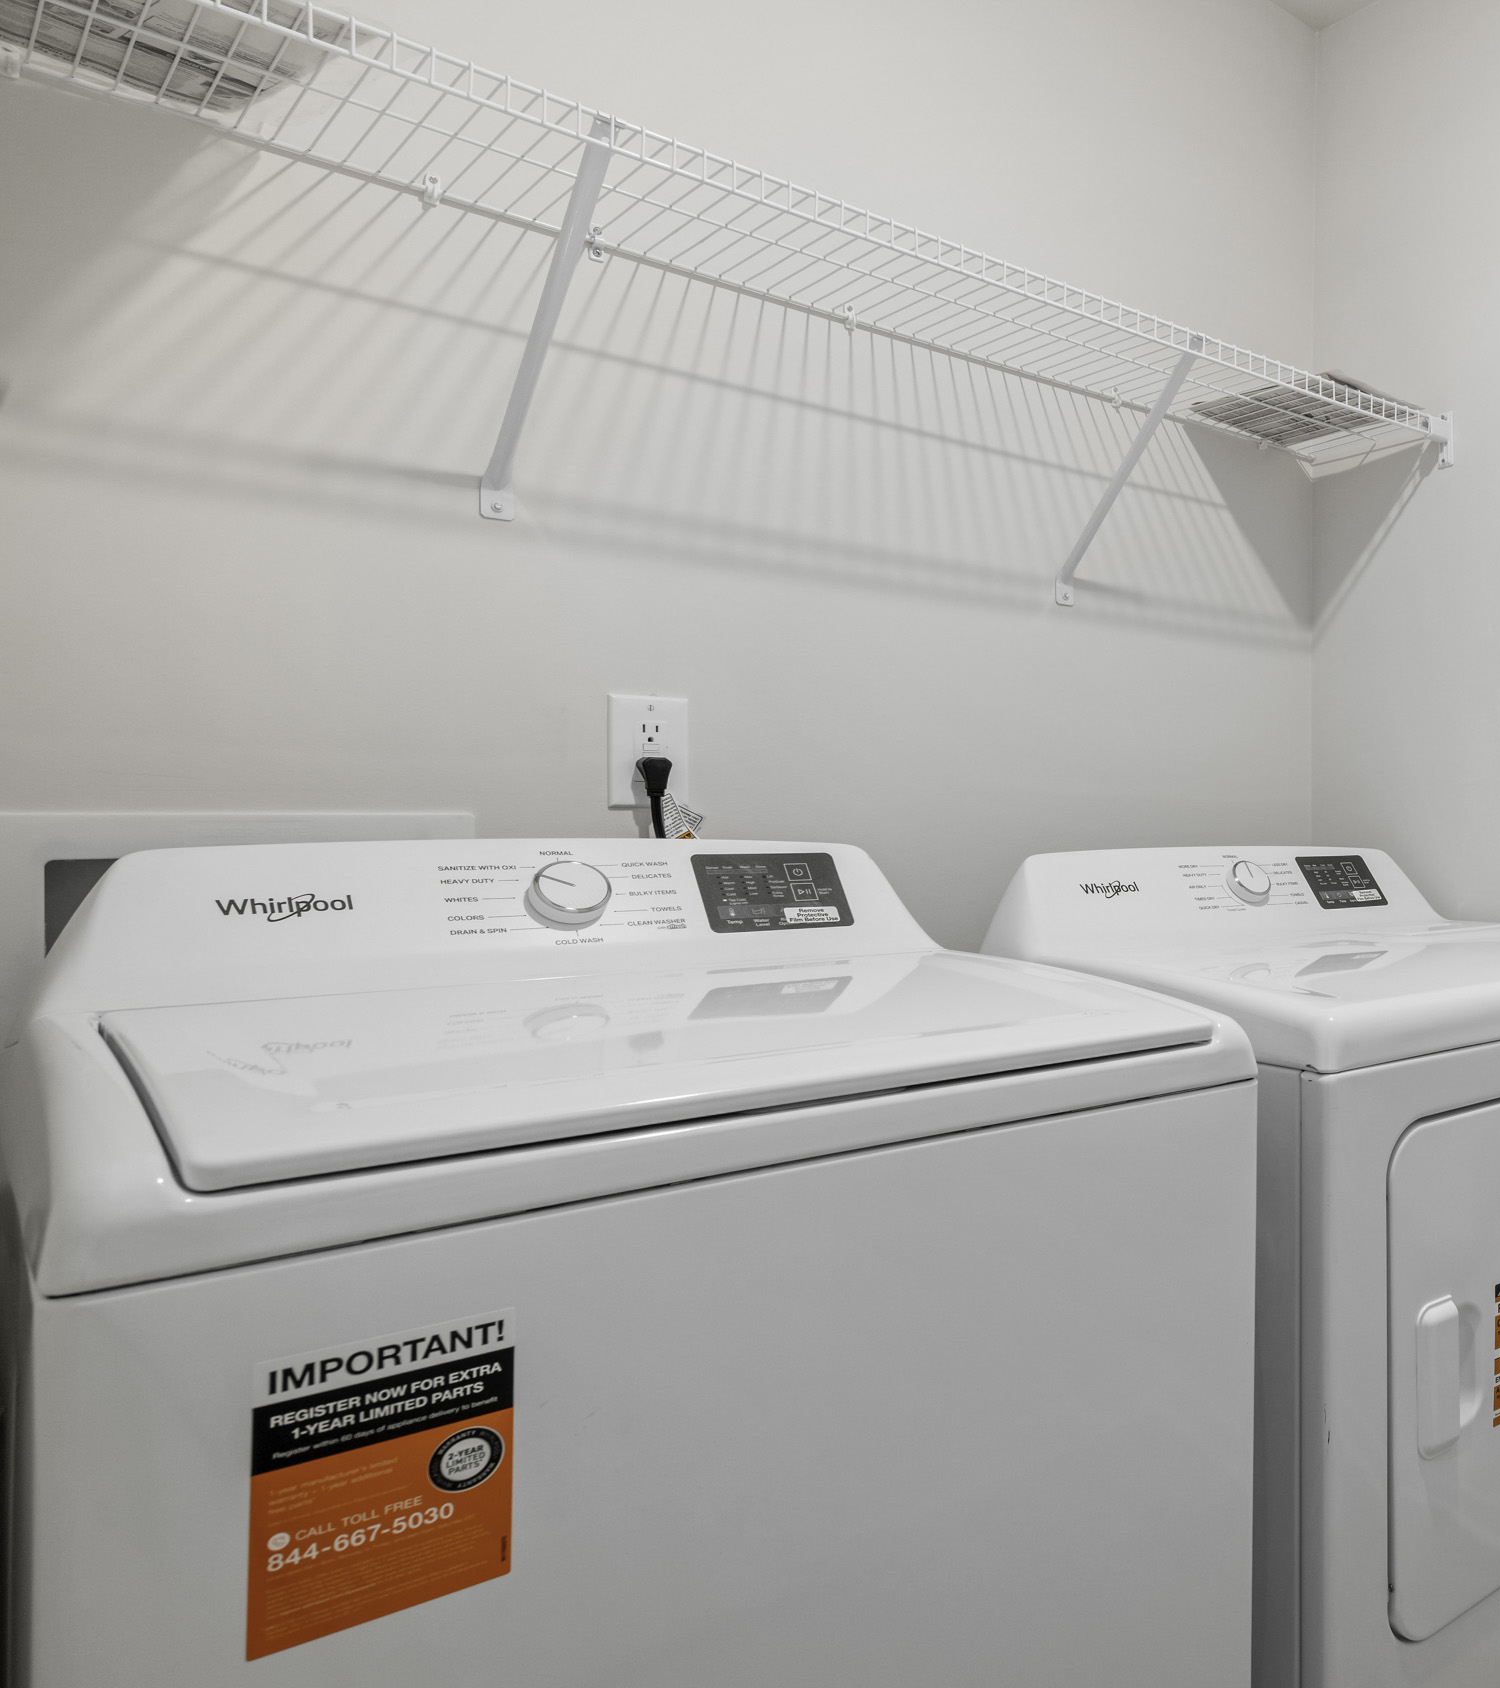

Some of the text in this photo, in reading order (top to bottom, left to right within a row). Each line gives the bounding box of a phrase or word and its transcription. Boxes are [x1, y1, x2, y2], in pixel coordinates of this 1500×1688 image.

[166, 54, 217, 75] WARNIG
[215, 893, 353, 922] Whirlpool
[1079, 880, 1140, 899] Whirlpool
[268, 1319, 504, 1396] IMPORTANT!
[269, 1362, 502, 1429] REGISTER NOW FOR EXTRA
[291, 1381, 485, 1439] 1-YEAR LIMITED PARTS
[272, 1445, 311, 1460] Register
[312, 1438, 339, 1449] within
[354, 1429, 375, 1440] days
[376, 1423, 386, 1433] of
[386, 1415, 428, 1431] appliance
[428, 1406, 460, 1420] delivery
[462, 1403, 470, 1411] to
[471, 1396, 498, 1409] benefit
[446, 1452, 486, 1469] LIMITED
[448, 1445, 484, 1461] 2-YEAR
[266, 1502, 455, 1573] 844-667-5030
[295, 1522, 336, 1542] CALL
[341, 1510, 380, 1528] TOLL
[384, 1495, 423, 1515] FREE
